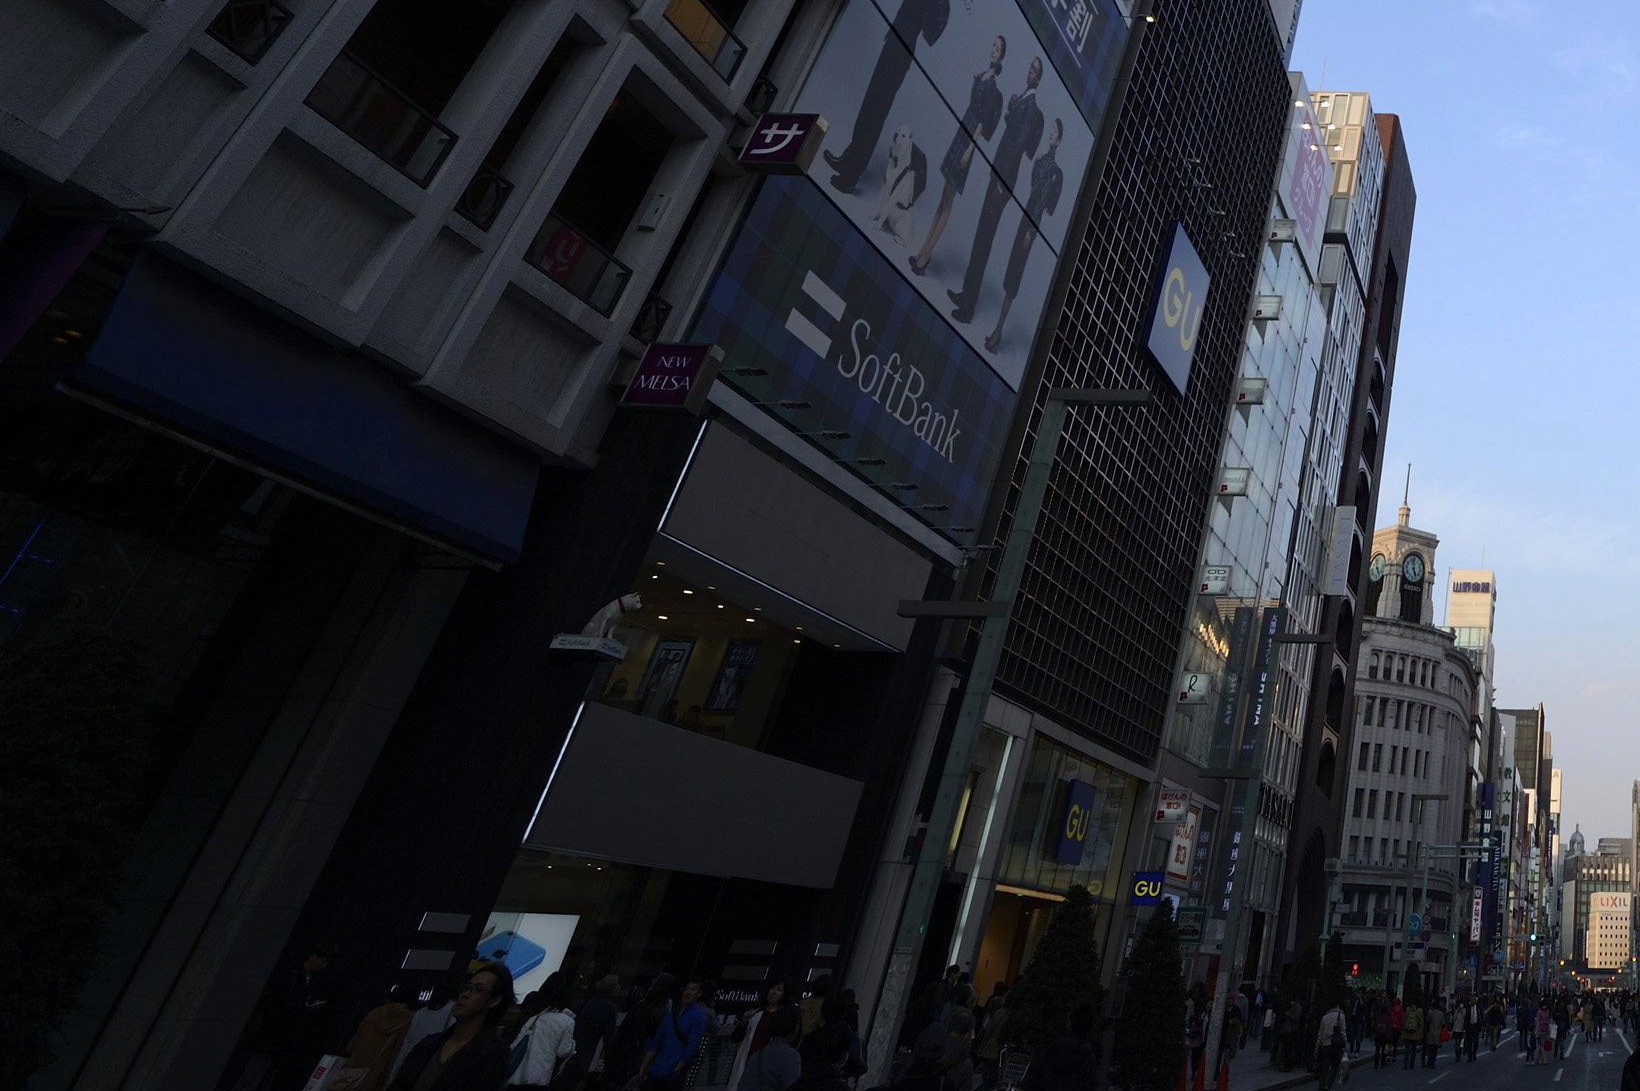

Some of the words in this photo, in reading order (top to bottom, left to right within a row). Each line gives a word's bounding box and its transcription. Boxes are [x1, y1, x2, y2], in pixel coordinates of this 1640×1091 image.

[1162, 267, 1199, 352] GU
[656, 355, 692, 370] NEW
[633, 373, 691, 392] MELSA
[837, 318, 964, 465] SoftBank
[1064, 802, 1086, 845] GU
[1134, 880, 1161, 896] GU
[1600, 896, 1627, 907] LIXIL
[714, 987, 760, 1004] SoftBank
